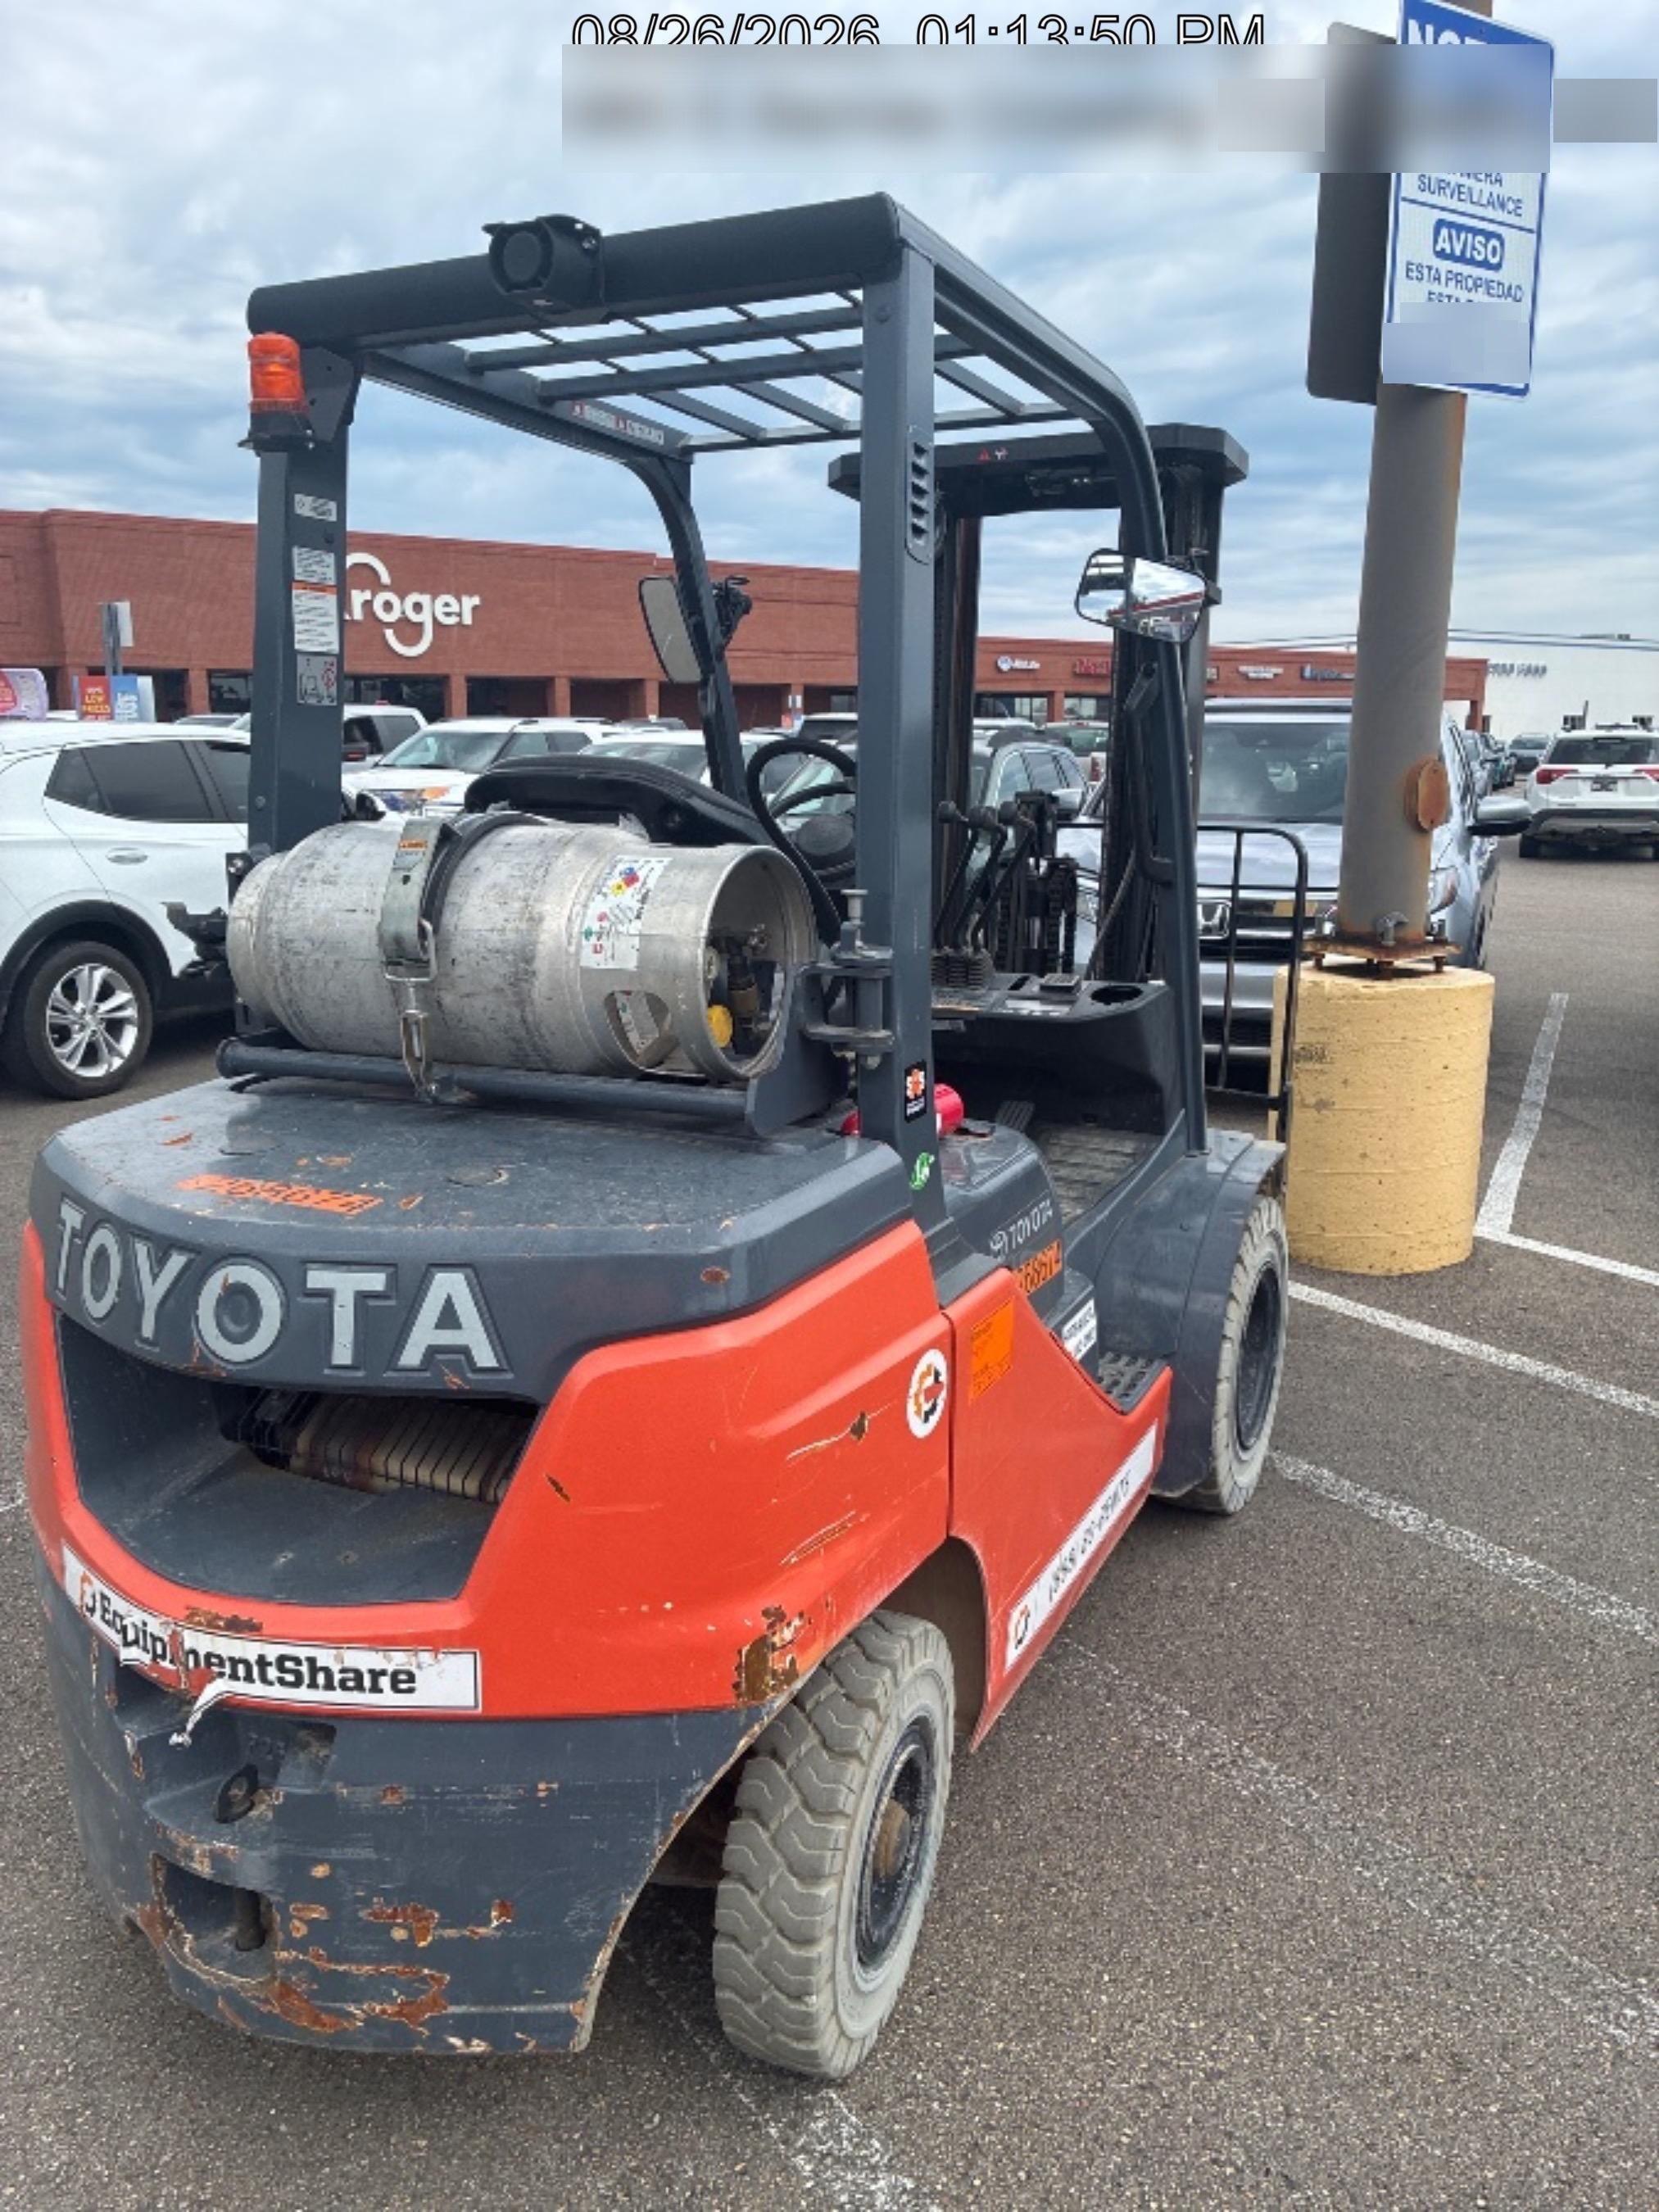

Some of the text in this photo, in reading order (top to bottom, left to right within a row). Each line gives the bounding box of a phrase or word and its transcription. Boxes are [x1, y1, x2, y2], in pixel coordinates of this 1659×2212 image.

[1417, 174, 1523, 217] SURVEILLANCE
[1435, 227, 1502, 264] AVISO
[1405, 261, 1525, 303] ESTA PROPIEDAD
[1010, 1199, 1054, 1250] TOYOTA
[57, 1199, 501, 1369] TOYOTA
